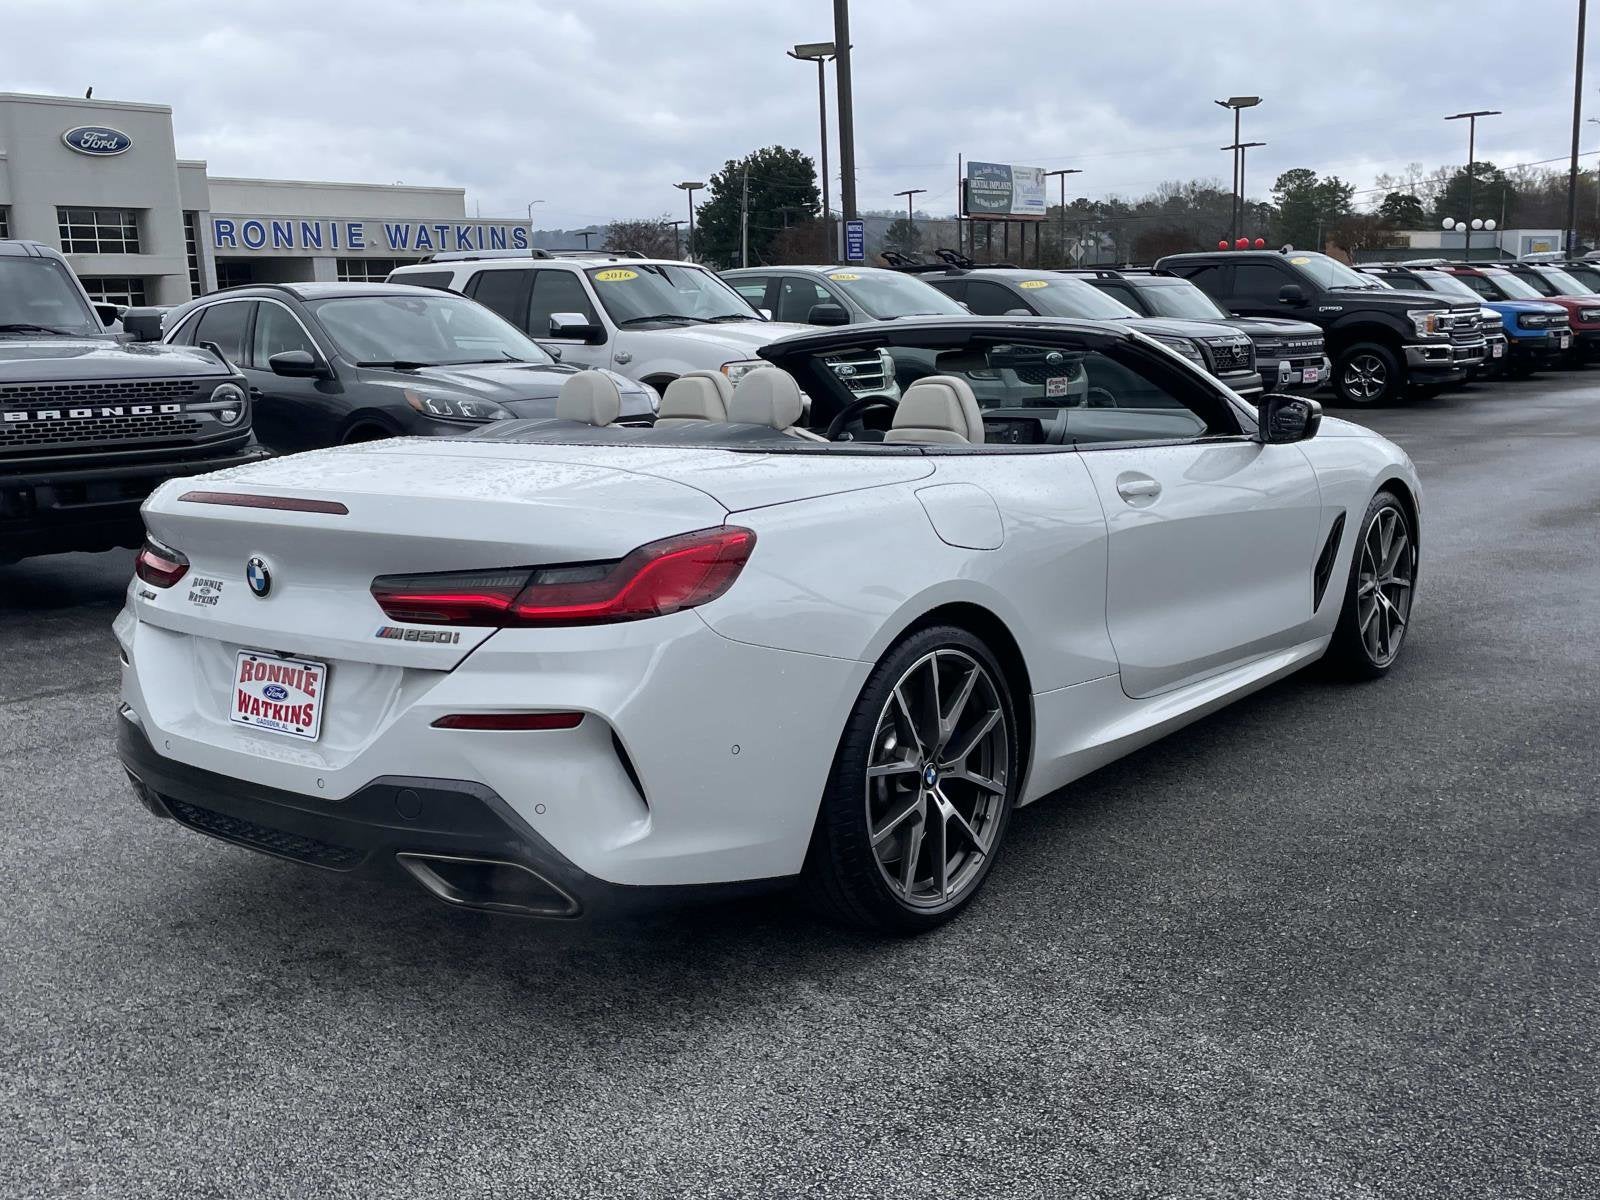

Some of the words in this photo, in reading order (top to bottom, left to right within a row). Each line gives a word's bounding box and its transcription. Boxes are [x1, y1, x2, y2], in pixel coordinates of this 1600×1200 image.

[80, 131, 118, 149] Ford
[214, 219, 365, 249] RONNIE
[385, 223, 529, 250] WATKINS
[604, 272, 631, 280] 2016
[3, 404, 181, 422] BRONCO
[192, 577, 224, 592] RONNIE
[188, 590, 219, 606] WATKINS
[240, 660, 319, 698] RONNIE
[266, 686, 286, 699] Ford
[238, 688, 314, 728] WATKINS
[281, 723, 289, 731] AL
